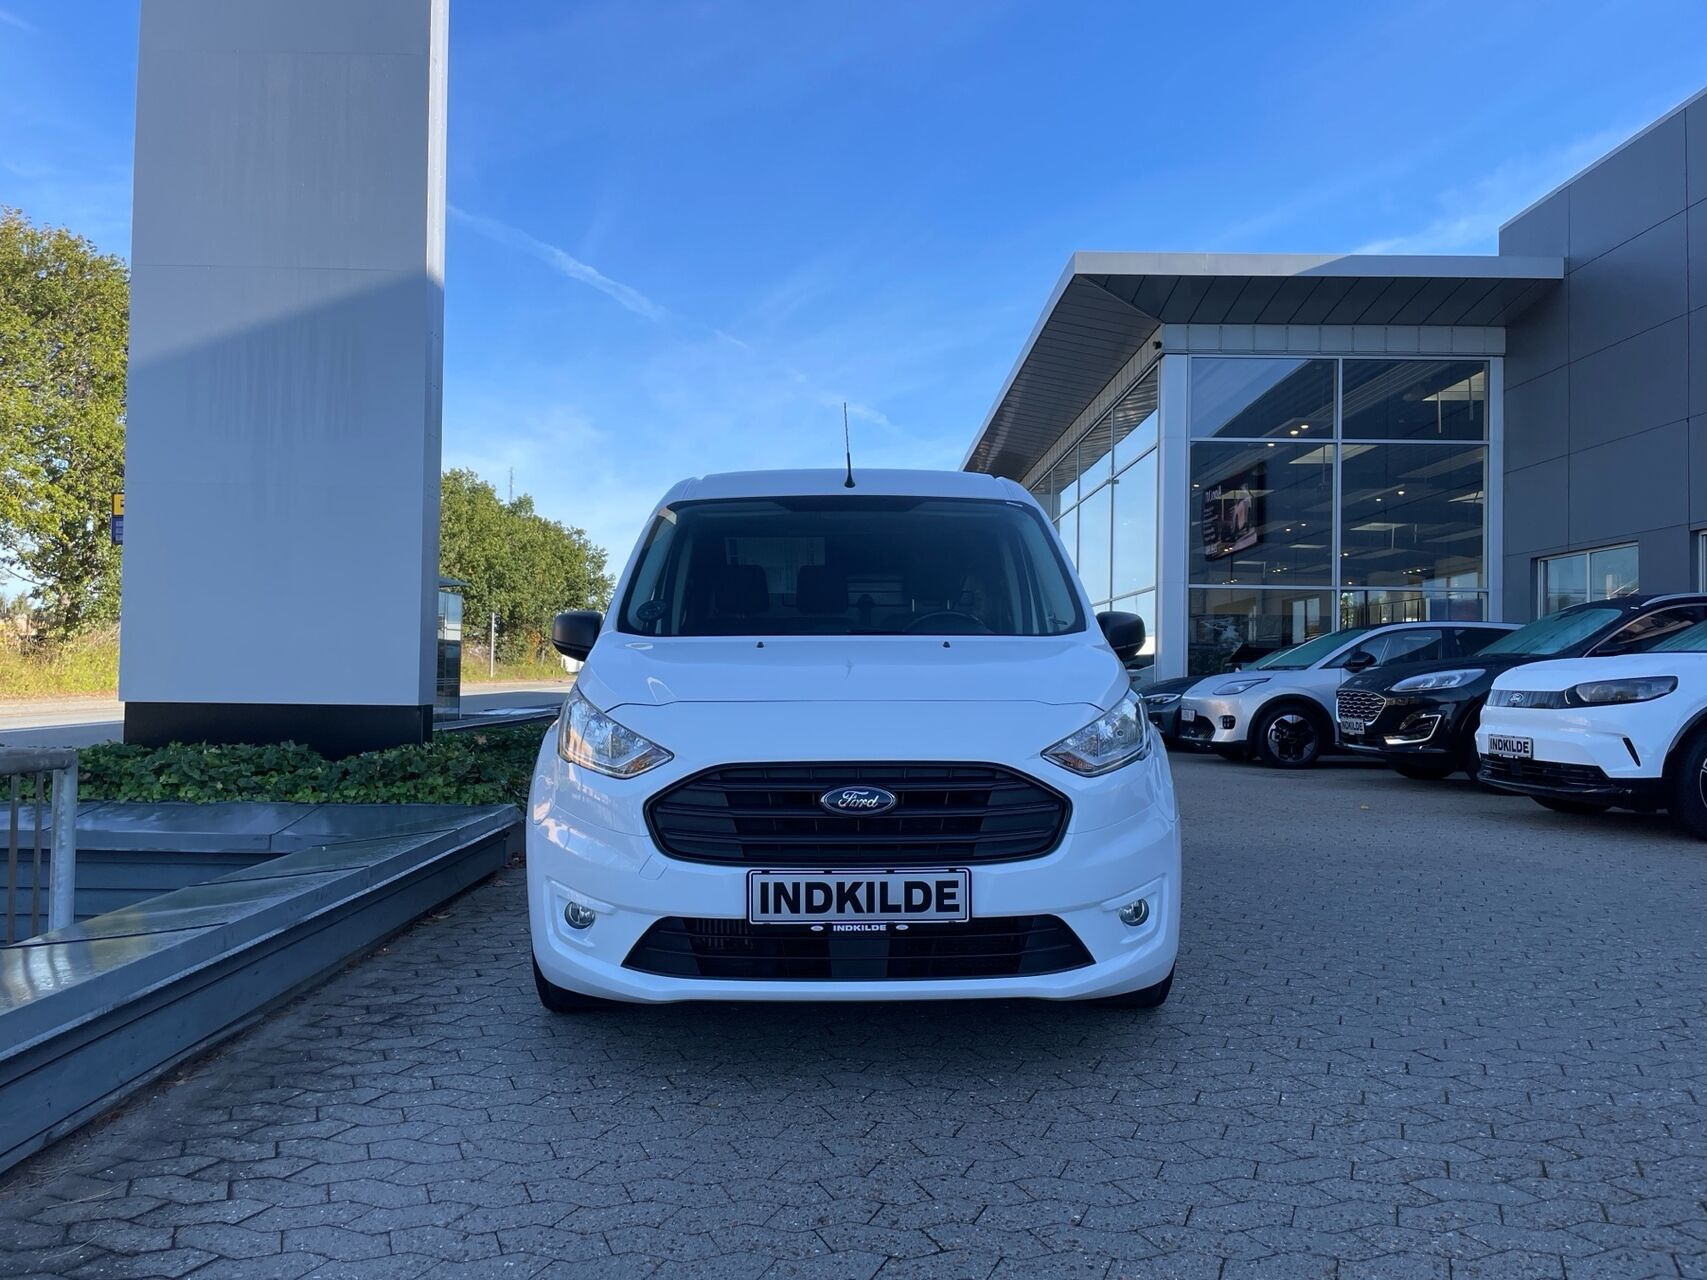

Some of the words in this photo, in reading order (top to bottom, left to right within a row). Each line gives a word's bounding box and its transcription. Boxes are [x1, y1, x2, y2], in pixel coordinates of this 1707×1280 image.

[1490, 738, 1530, 754] INDKILDE
[838, 790, 880, 809] Ford
[760, 880, 960, 914] INDKILDE
[833, 924, 887, 932] INDKILDE
